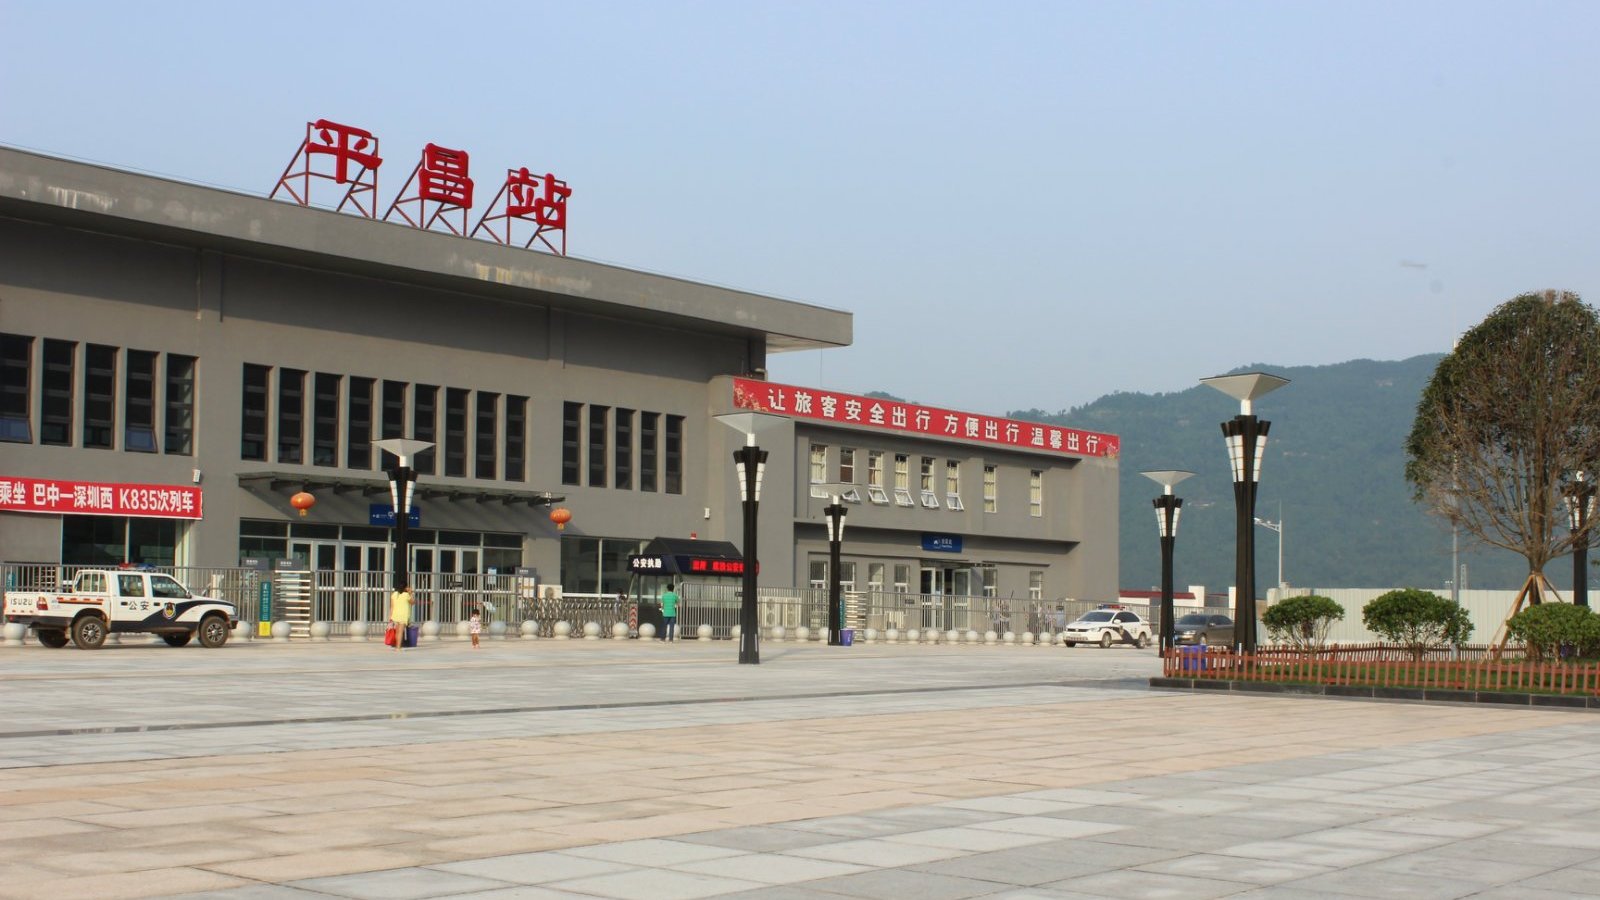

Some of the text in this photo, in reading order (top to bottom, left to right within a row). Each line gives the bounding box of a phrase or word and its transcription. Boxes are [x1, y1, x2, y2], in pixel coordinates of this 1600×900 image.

[305, 118, 572, 229] 平昌站
[768, 388, 1099, 454] 让旅客安全出行 方便出行 温馨出行
[119, 488, 194, 514] K835次列车
[632, 558, 662, 569] 公安执勤
[10, 598, 33, 606] ISUZU
[128, 601, 151, 611] 公安
